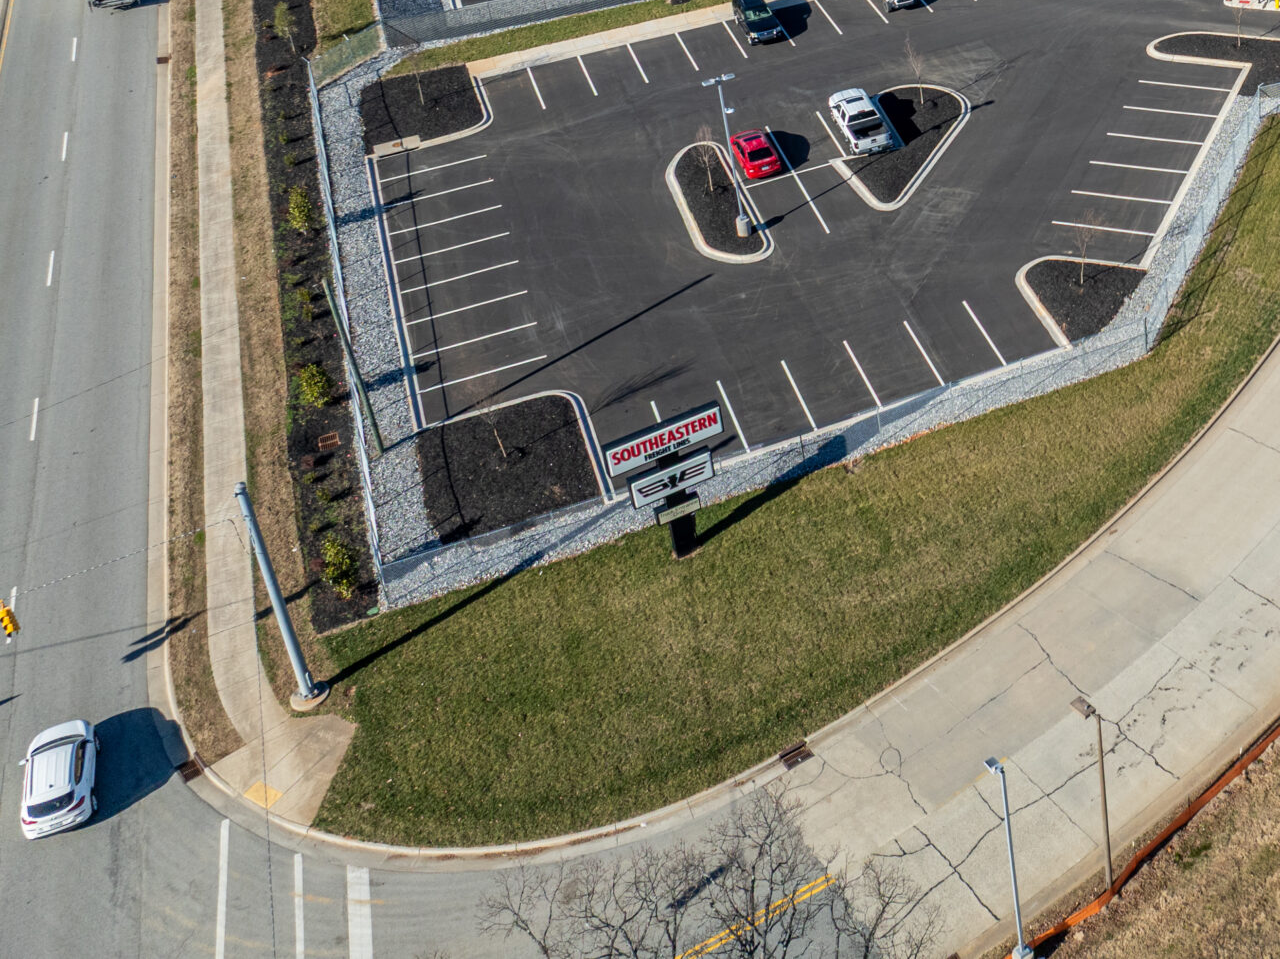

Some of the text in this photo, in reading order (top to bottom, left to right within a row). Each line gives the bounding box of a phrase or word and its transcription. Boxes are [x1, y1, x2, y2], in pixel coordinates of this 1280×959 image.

[611, 412, 718, 466] SOUTHEASTERN
[644, 438, 691, 462] FREIGHT LINES
